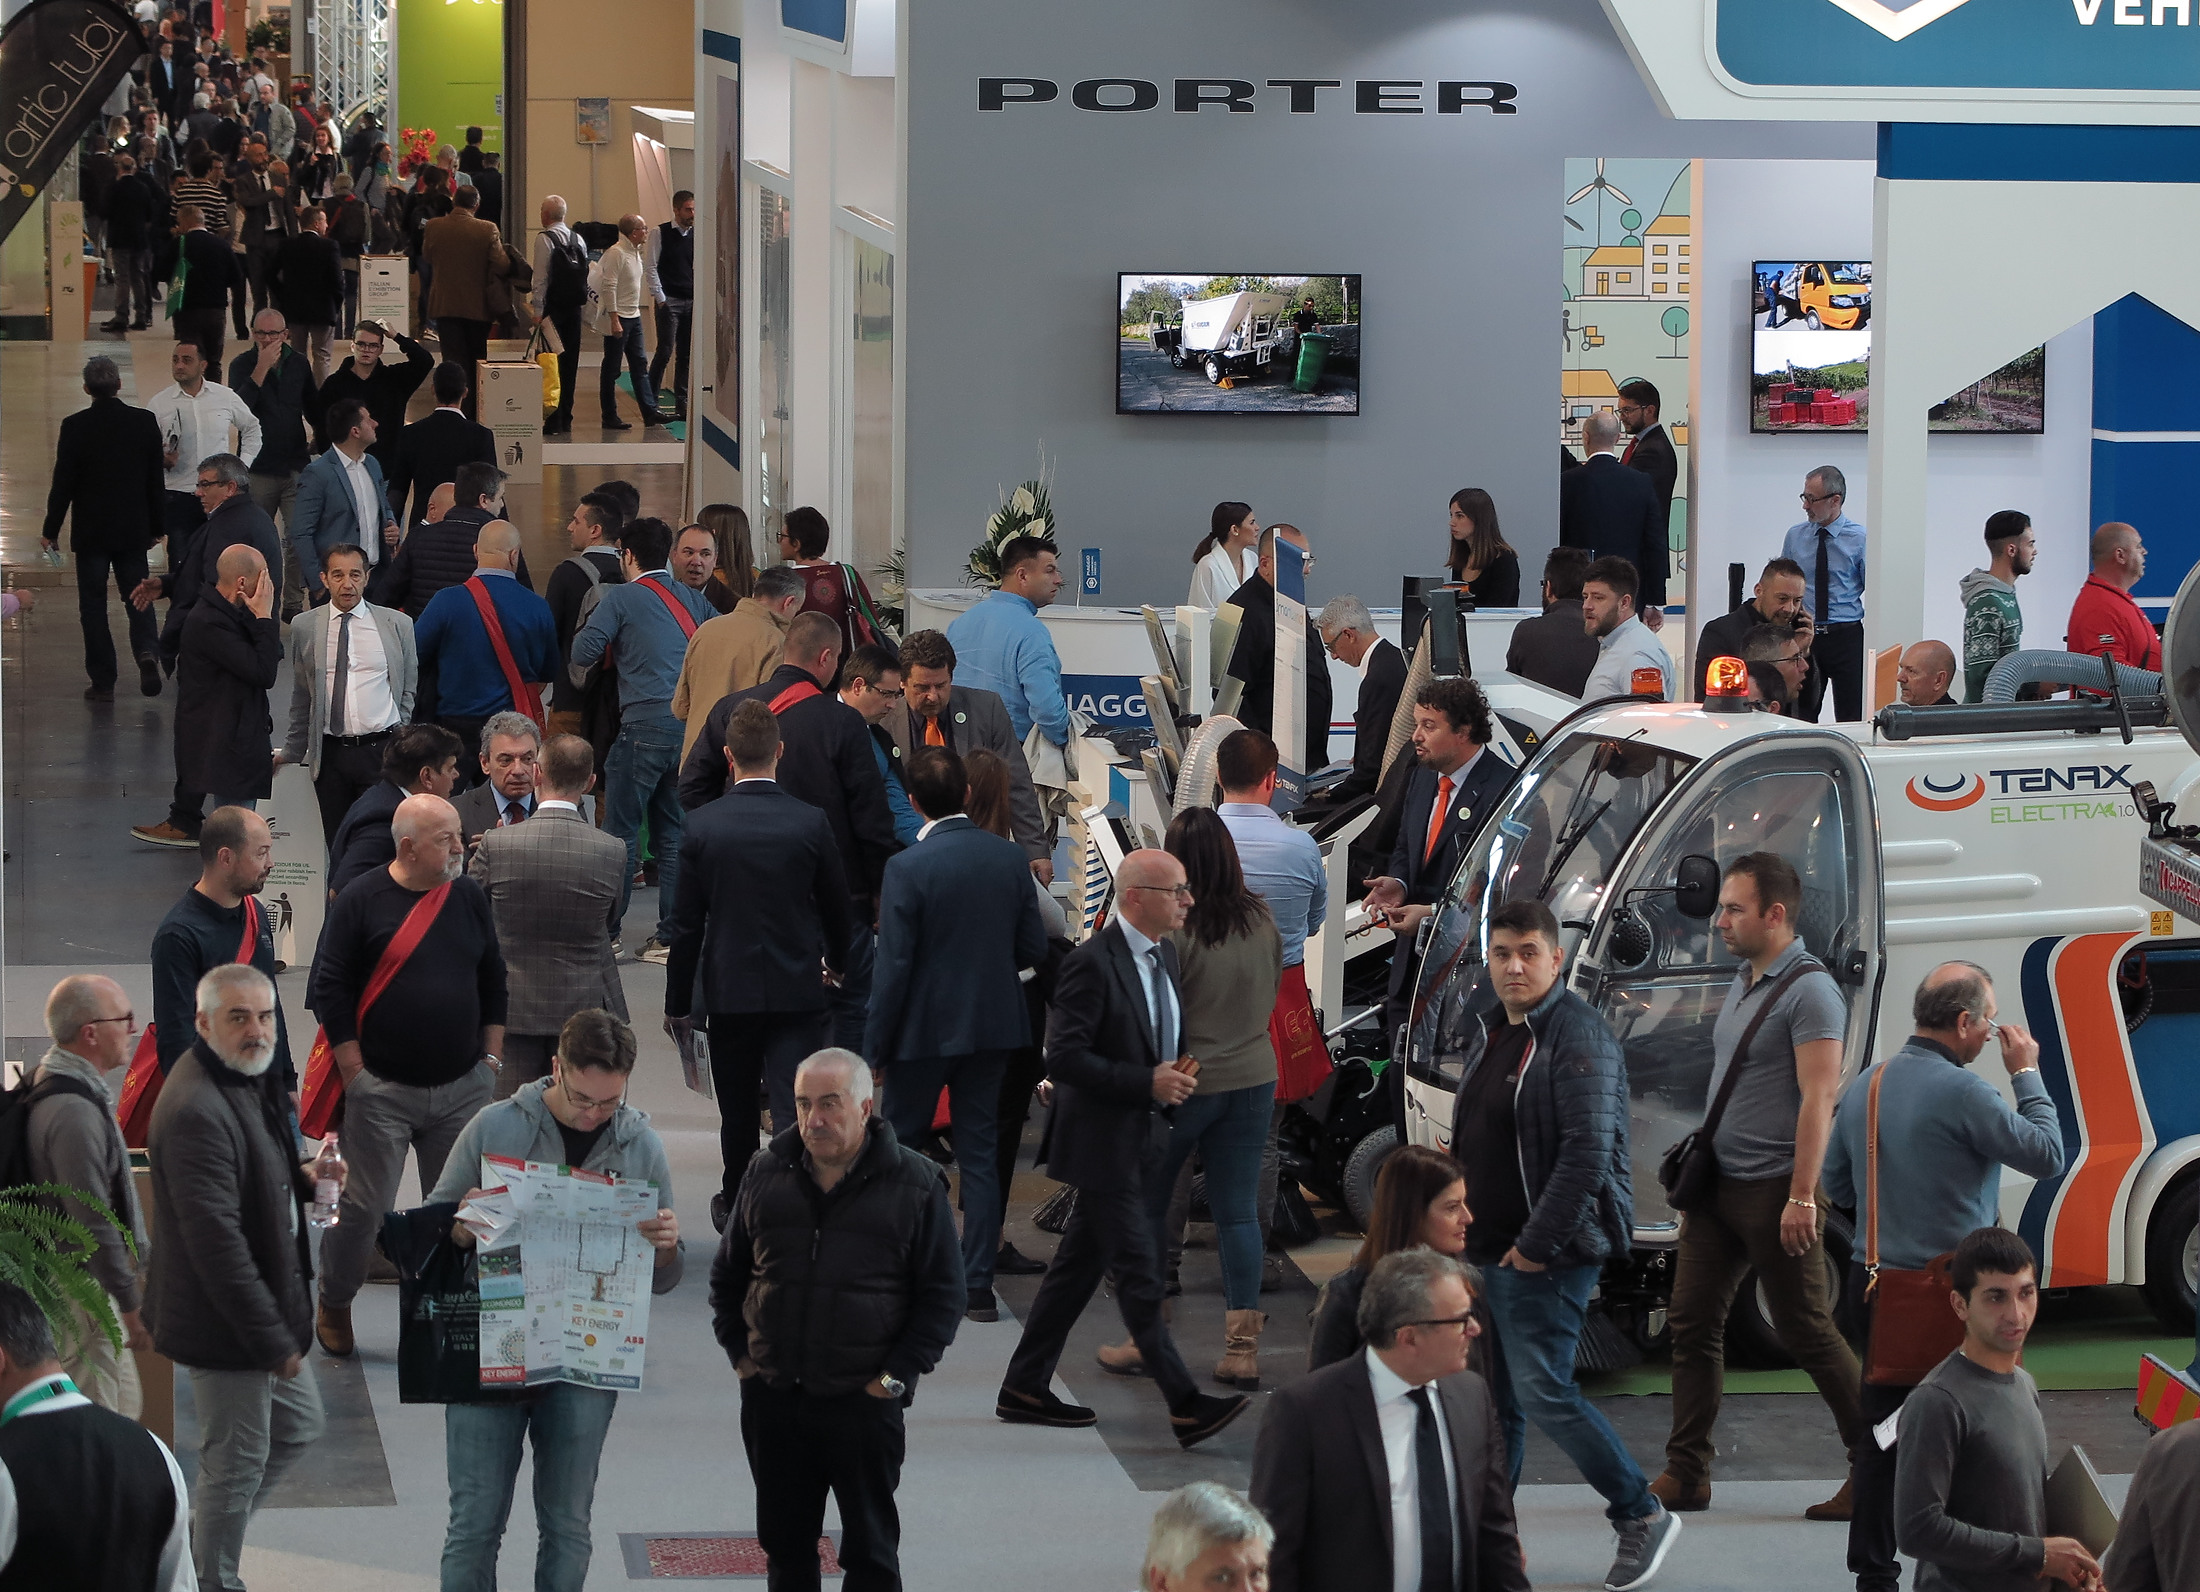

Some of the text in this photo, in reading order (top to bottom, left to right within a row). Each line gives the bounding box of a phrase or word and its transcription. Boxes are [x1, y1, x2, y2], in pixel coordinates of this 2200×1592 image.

[2071, 0, 2200, 26] VEH
[976, 76, 1519, 115] PORTER
[4, 83, 68, 158] artic
[1067, 693, 1147, 717] IAGG
[1989, 764, 2134, 793] TENAX
[1990, 802, 2135, 824] ELECTRA 1.0
[571, 1315, 620, 1332] KEY ENERGY
[624, 1336, 644, 1345] ABB
[482, 1369, 522, 1379] KEY ENERGY
